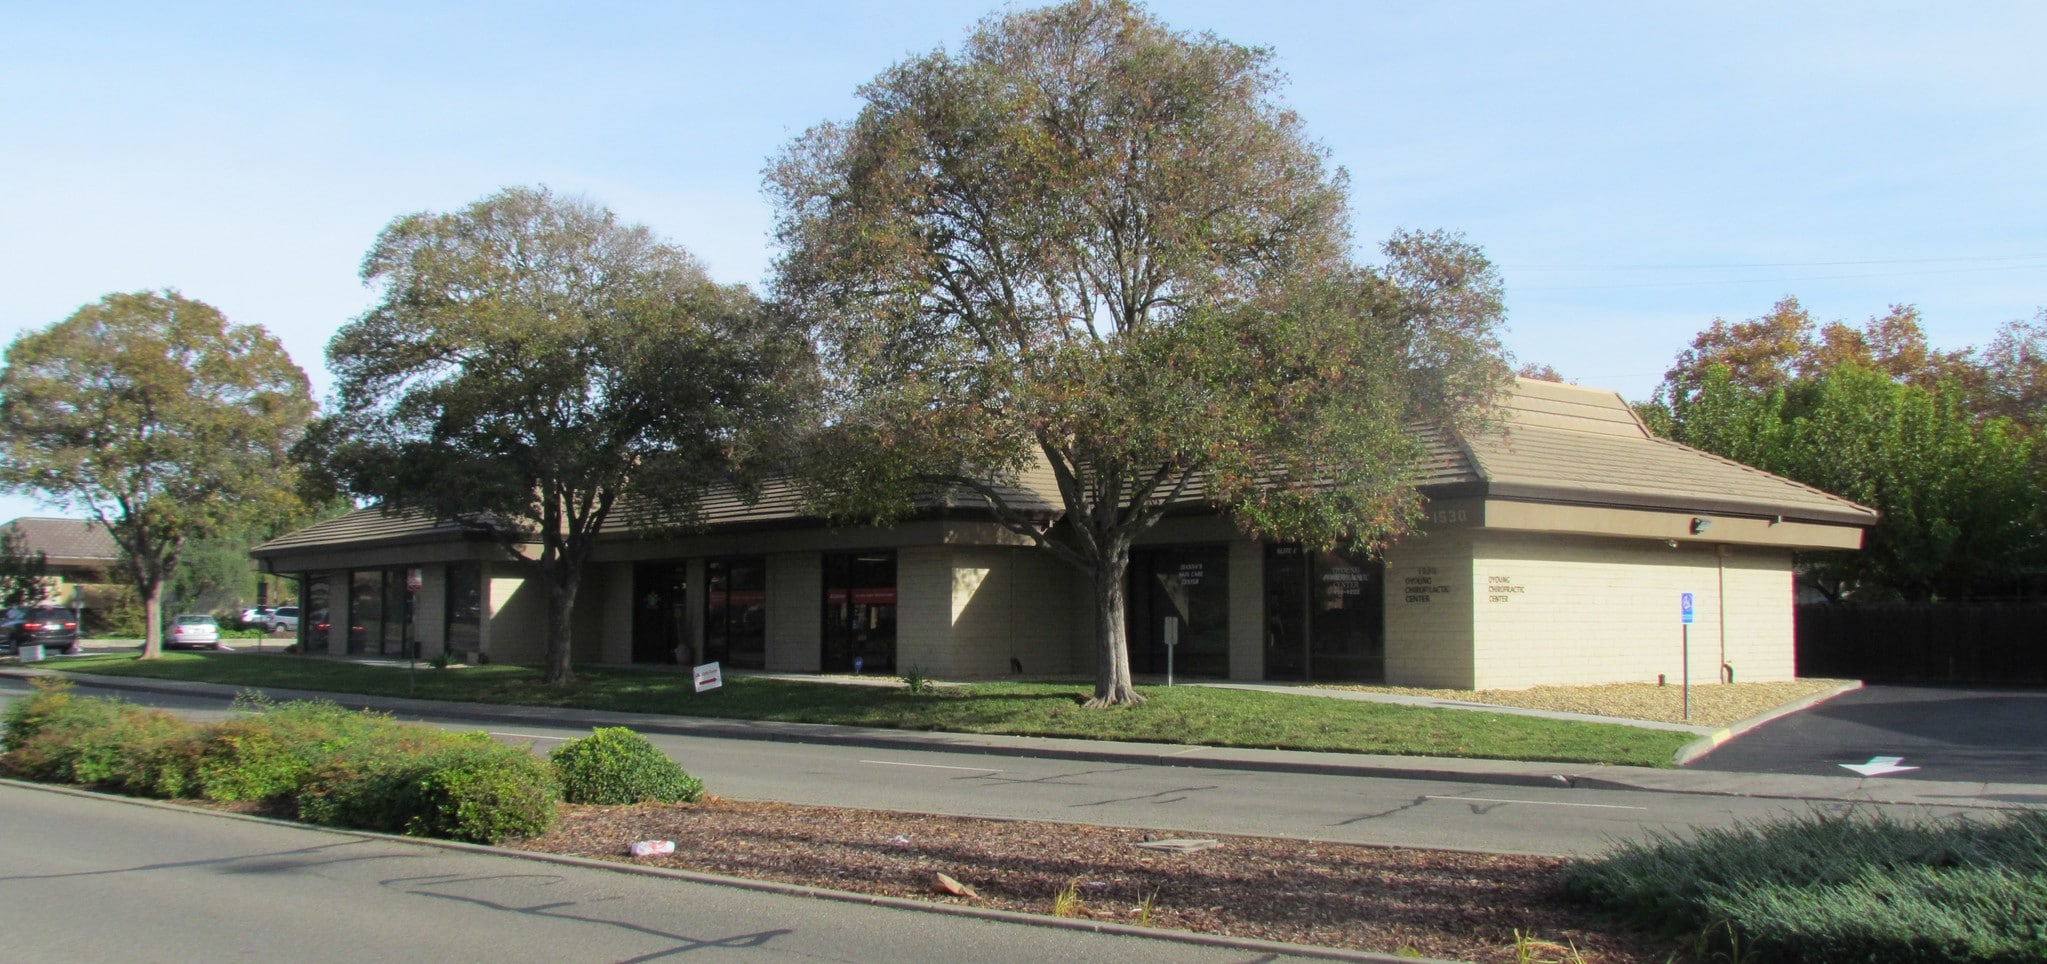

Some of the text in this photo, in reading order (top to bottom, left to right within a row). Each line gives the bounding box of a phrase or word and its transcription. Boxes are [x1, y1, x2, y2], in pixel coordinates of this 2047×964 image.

[1433, 510, 1467, 523] 1530
[1488, 575, 1510, 583] OYOUNG
[1488, 585, 1525, 593] CHIROPRACTIC
[1405, 595, 1430, 603] CENTER
